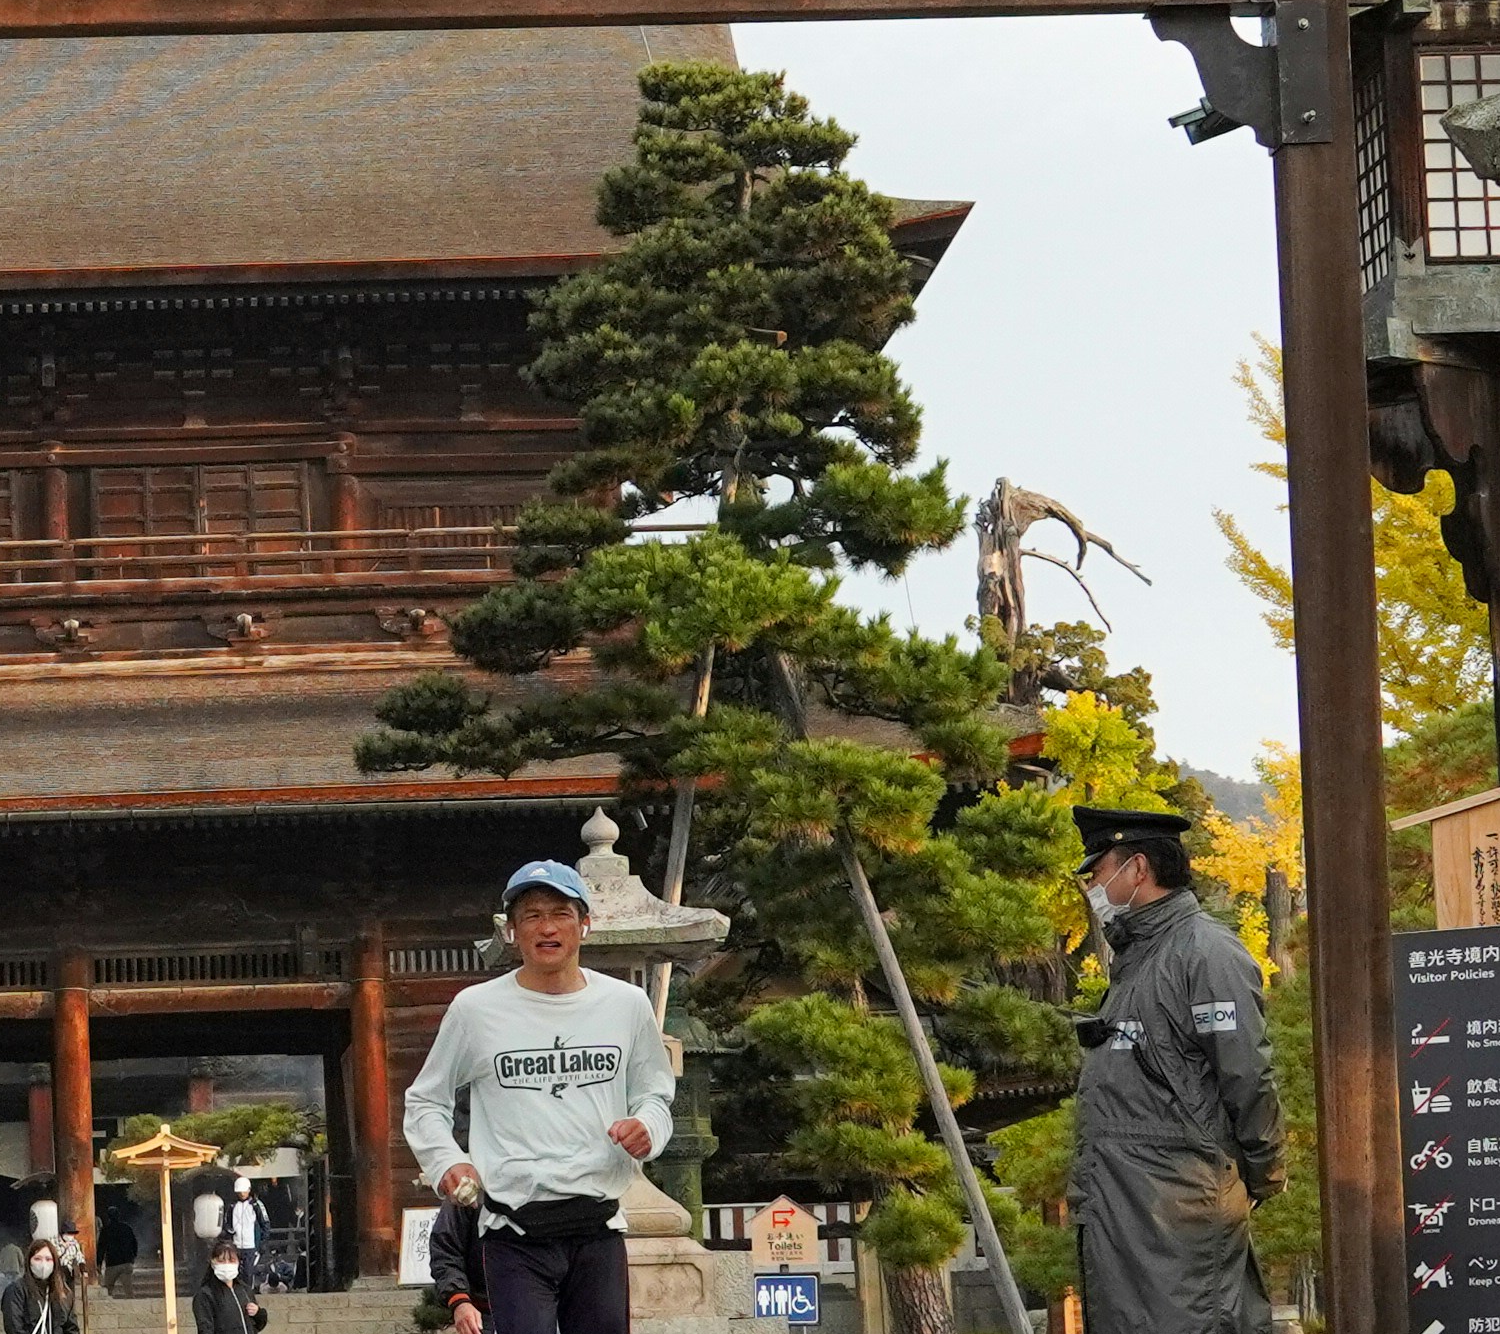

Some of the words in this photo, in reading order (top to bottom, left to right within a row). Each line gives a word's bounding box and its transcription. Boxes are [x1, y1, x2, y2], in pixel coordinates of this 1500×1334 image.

[1409, 972, 1447, 984] Visitor
[1450, 968, 1495, 981] Policies
[1194, 1010, 1236, 1025] SEOM
[1466, 1039, 1481, 1048] No
[500, 1051, 556, 1079] Great
[560, 1050, 616, 1072] Lakes
[512, 1077, 531, 1085] THE
[533, 1075, 552, 1084] LIFE
[557, 1074, 581, 1083] WITH
[1467, 1098, 1482, 1107] No
[1467, 1157, 1482, 1167] No
[1468, 1216, 1500, 1226] Drones
[768, 1241, 803, 1251] Toilets
[1468, 1275, 1493, 1287] Keep
